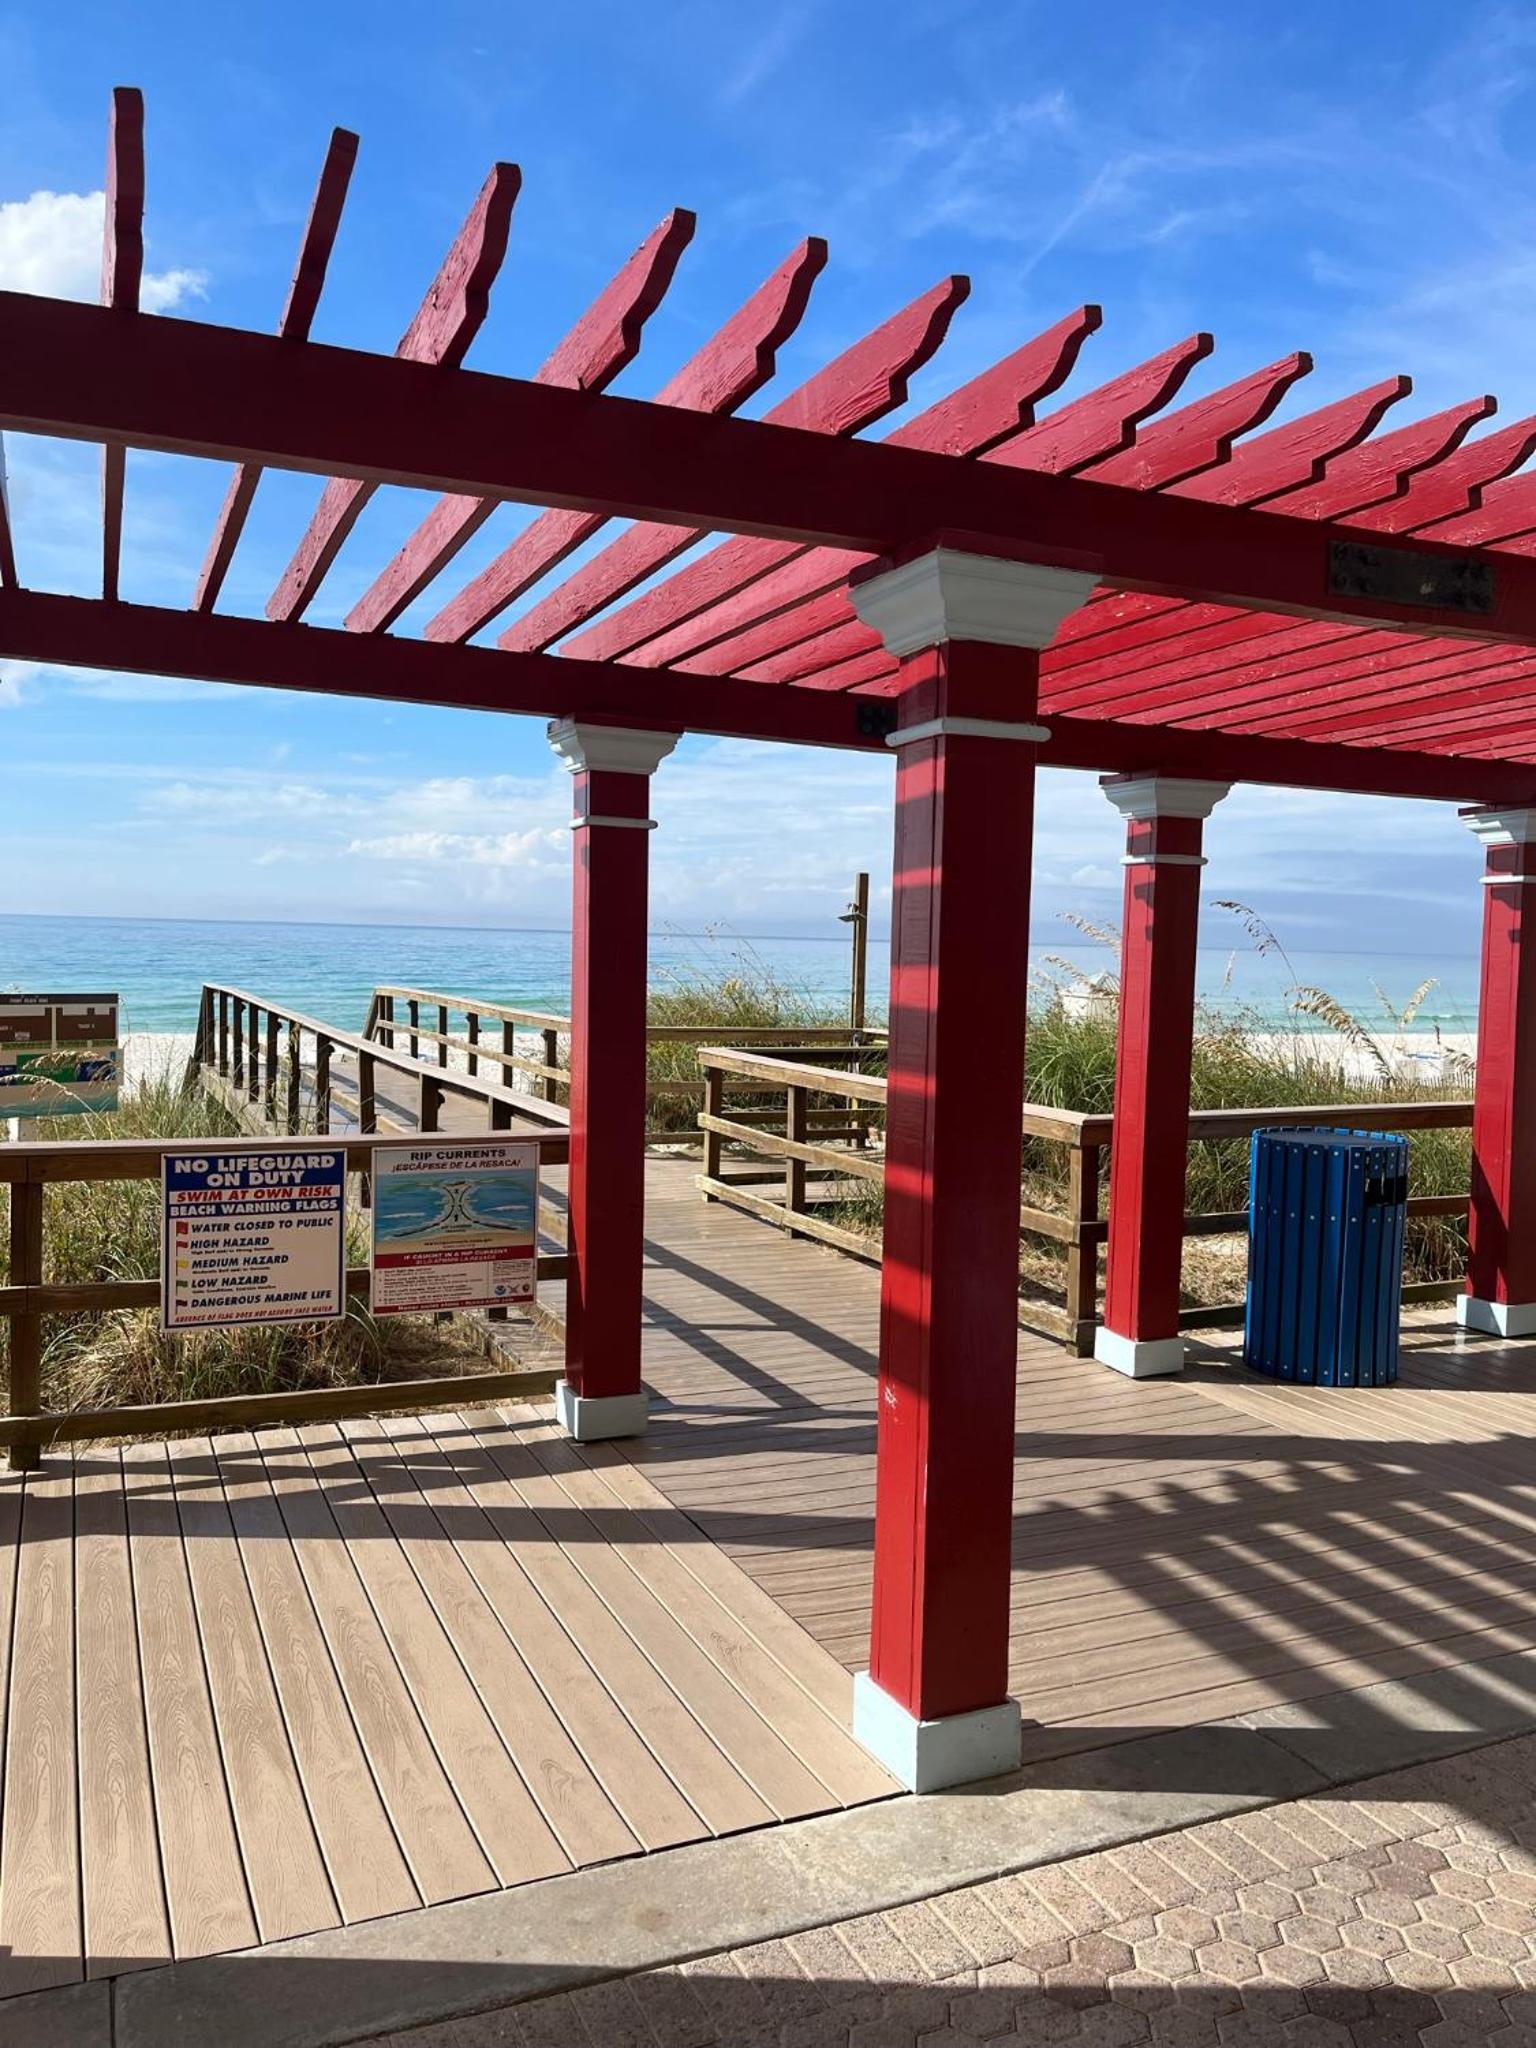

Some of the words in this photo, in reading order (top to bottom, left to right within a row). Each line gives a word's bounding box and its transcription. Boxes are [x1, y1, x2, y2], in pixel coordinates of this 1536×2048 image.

[410, 1151, 432, 1161] RIP
[436, 1149, 506, 1160] CURRENTS
[175, 1159, 209, 1173] NO
[218, 1155, 336, 1172] LIFEGUARD
[450, 1161, 463, 1169] DE
[478, 1159, 521, 1168] RESACA!
[207, 1173, 241, 1187] ON
[250, 1170, 305, 1185] DUTY
[177, 1190, 222, 1202] SWIM
[229, 1190, 249, 1200] AT
[254, 1188, 293, 1199] OWN
[298, 1186, 333, 1197] RISK
[170, 1204, 216, 1217] BEACH
[221, 1202, 291, 1215] WARNING
[296, 1199, 338, 1210] FLAGS
[191, 1222, 230, 1233] WATER
[234, 1220, 275, 1231] CLOSED
[279, 1219, 293, 1228] TO
[297, 1217, 334, 1228] PUBLIC
[190, 1238, 220, 1249] HIGH
[223, 1236, 270, 1247] HAZARD
[192, 1257, 239, 1269] MEDIUM
[243, 1254, 289, 1266] HAZARD
[191, 1277, 219, 1288] LOW
[221, 1275, 268, 1286] HAZARD
[191, 1294, 262, 1308] DANGEROUS
[265, 1291, 308, 1303] MARINE
[311, 1290, 333, 1300] LIFE
